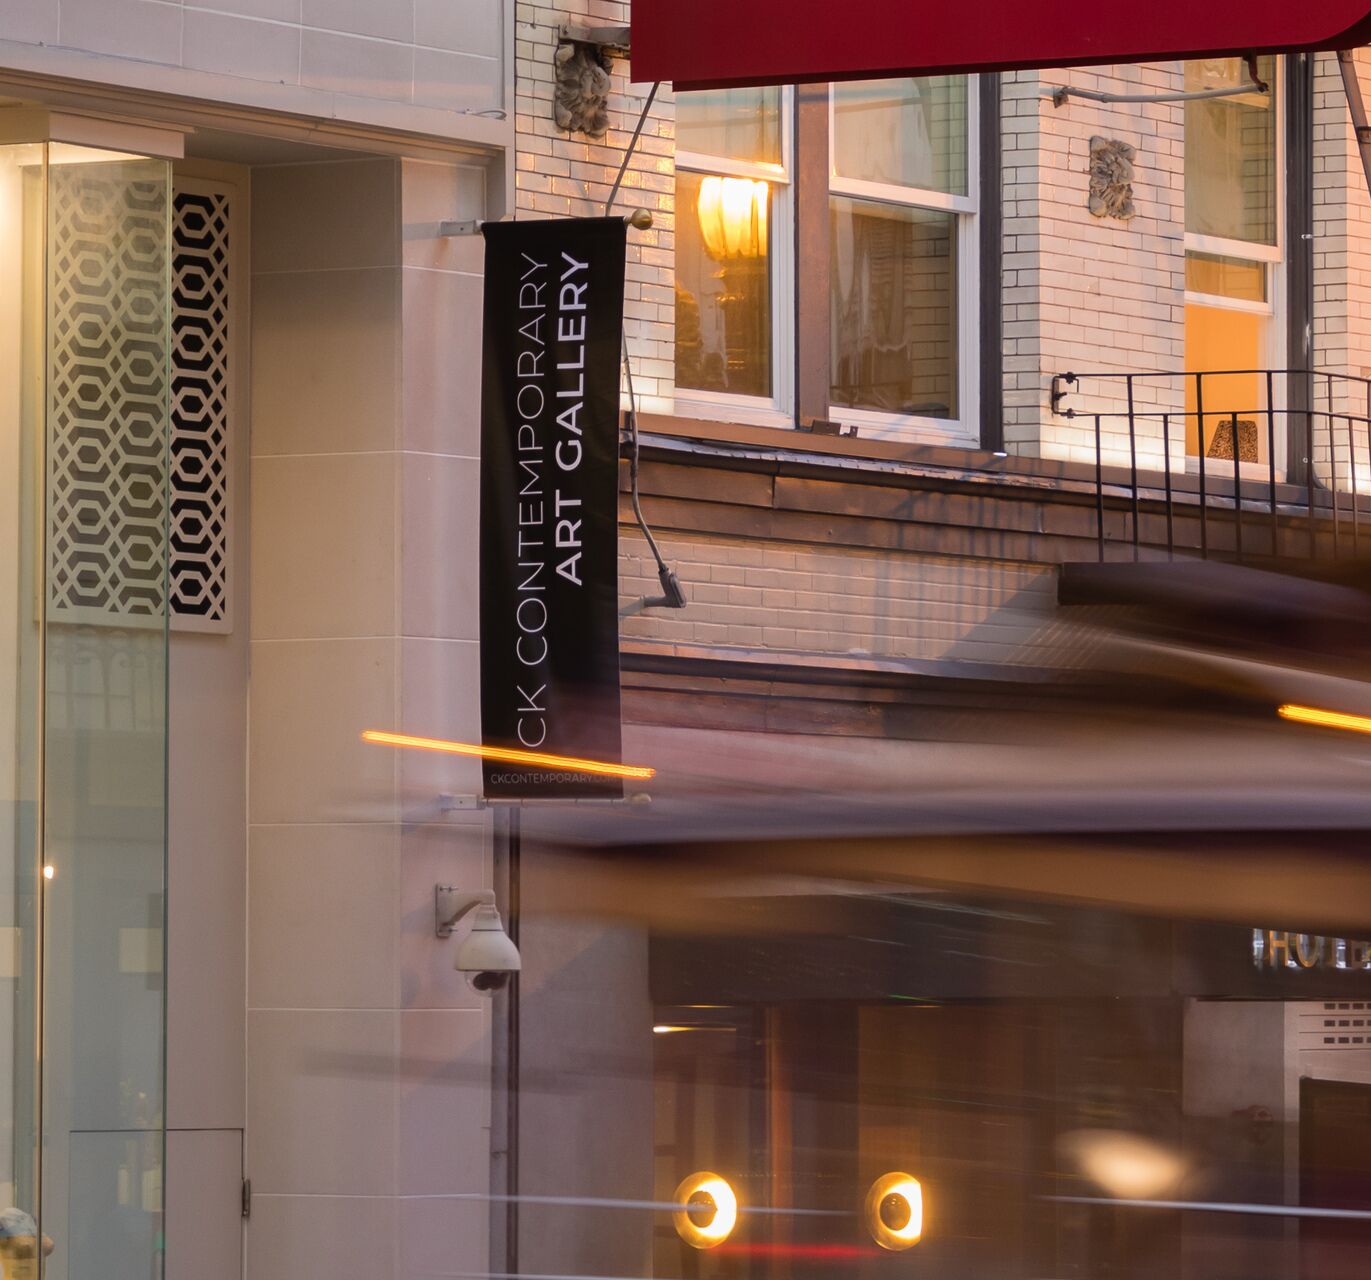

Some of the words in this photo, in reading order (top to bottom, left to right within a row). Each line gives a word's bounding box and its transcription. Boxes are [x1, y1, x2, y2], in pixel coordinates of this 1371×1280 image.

[555, 251, 590, 472] GALLERY
[516, 252, 549, 667] CONTEMPORARY
[555, 489, 583, 587] ART
[516, 683, 547, 748] CK
